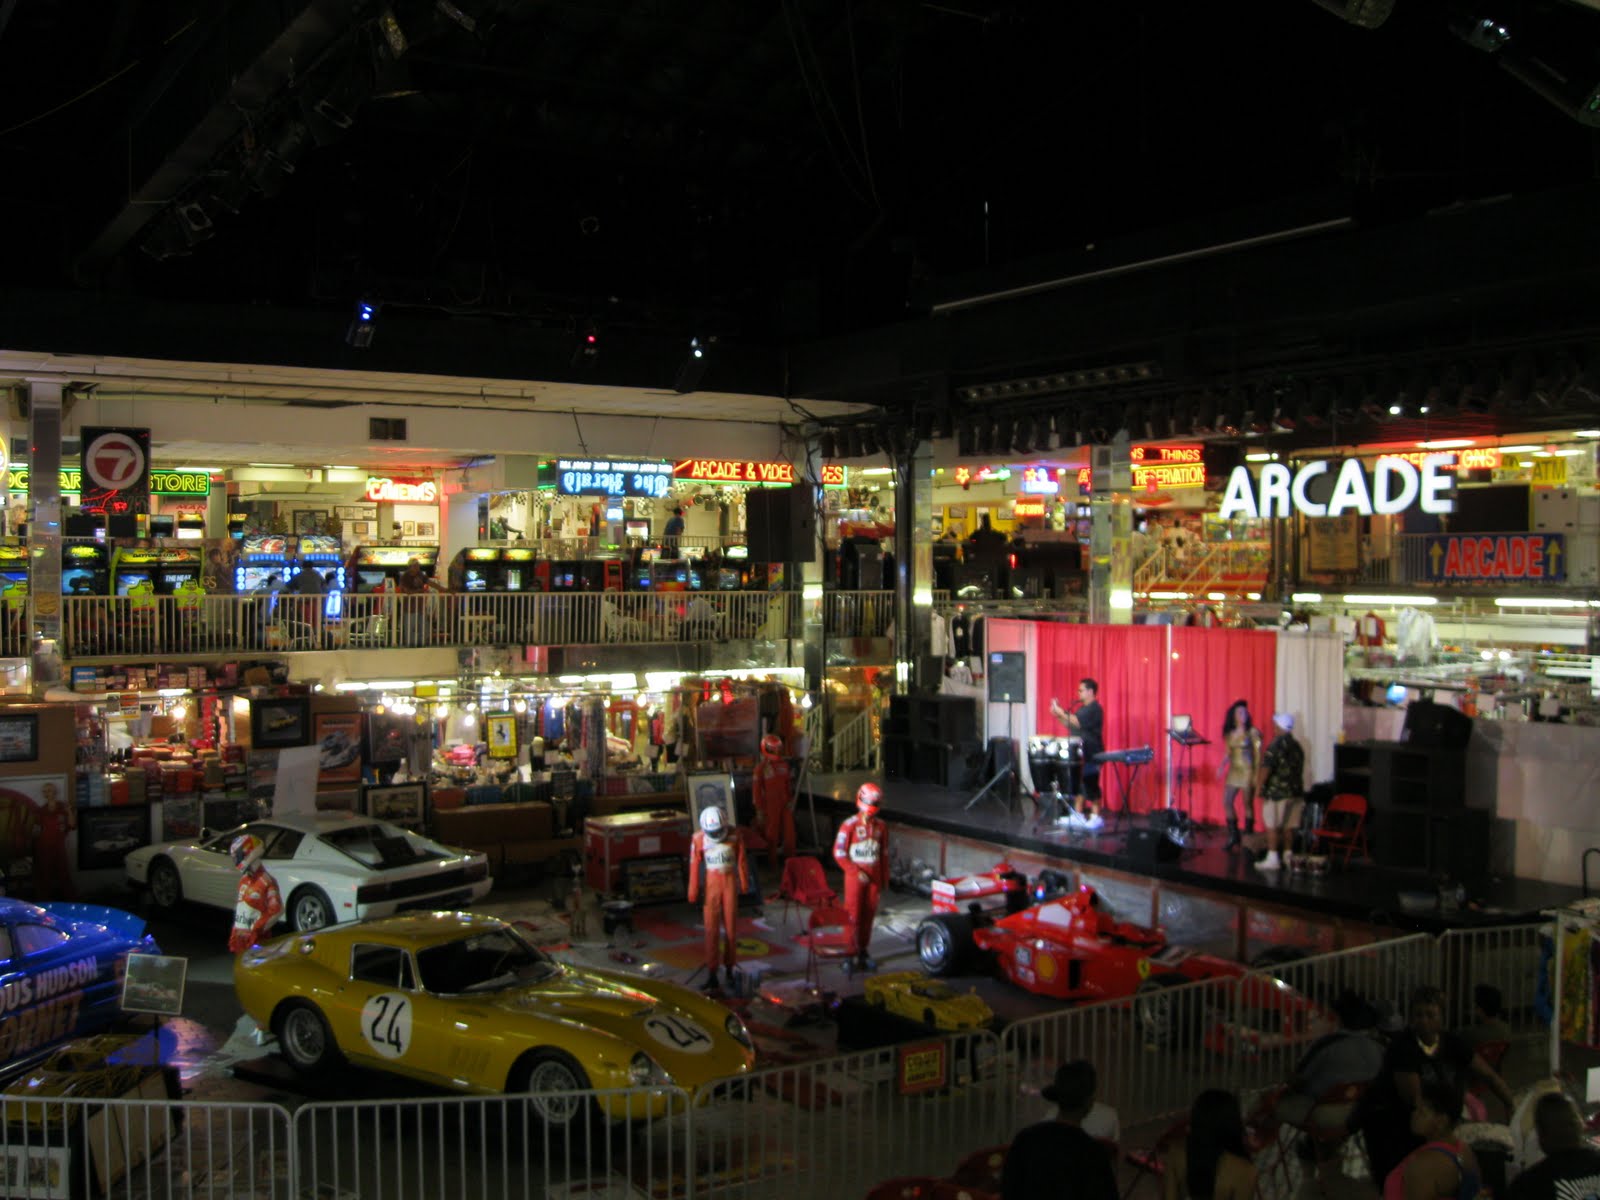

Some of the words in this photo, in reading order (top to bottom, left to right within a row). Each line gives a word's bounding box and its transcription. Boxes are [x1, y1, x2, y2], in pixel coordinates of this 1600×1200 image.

[1160, 448, 1201, 461] THINGS
[691, 460, 742, 479] ARCADE
[746, 462, 757, 480] &
[1135, 466, 1205, 485] RESERVATION
[1533, 458, 1566, 480] ATM
[563, 471, 626, 495] Herald
[633, 473, 670, 498] The
[1219, 456, 1455, 519] ARCADE
[1445, 536, 1545, 578] ARCADE
[36, 955, 98, 1000] HUDSON
[371, 995, 406, 1054] 24
[647, 1014, 712, 1048] 24
